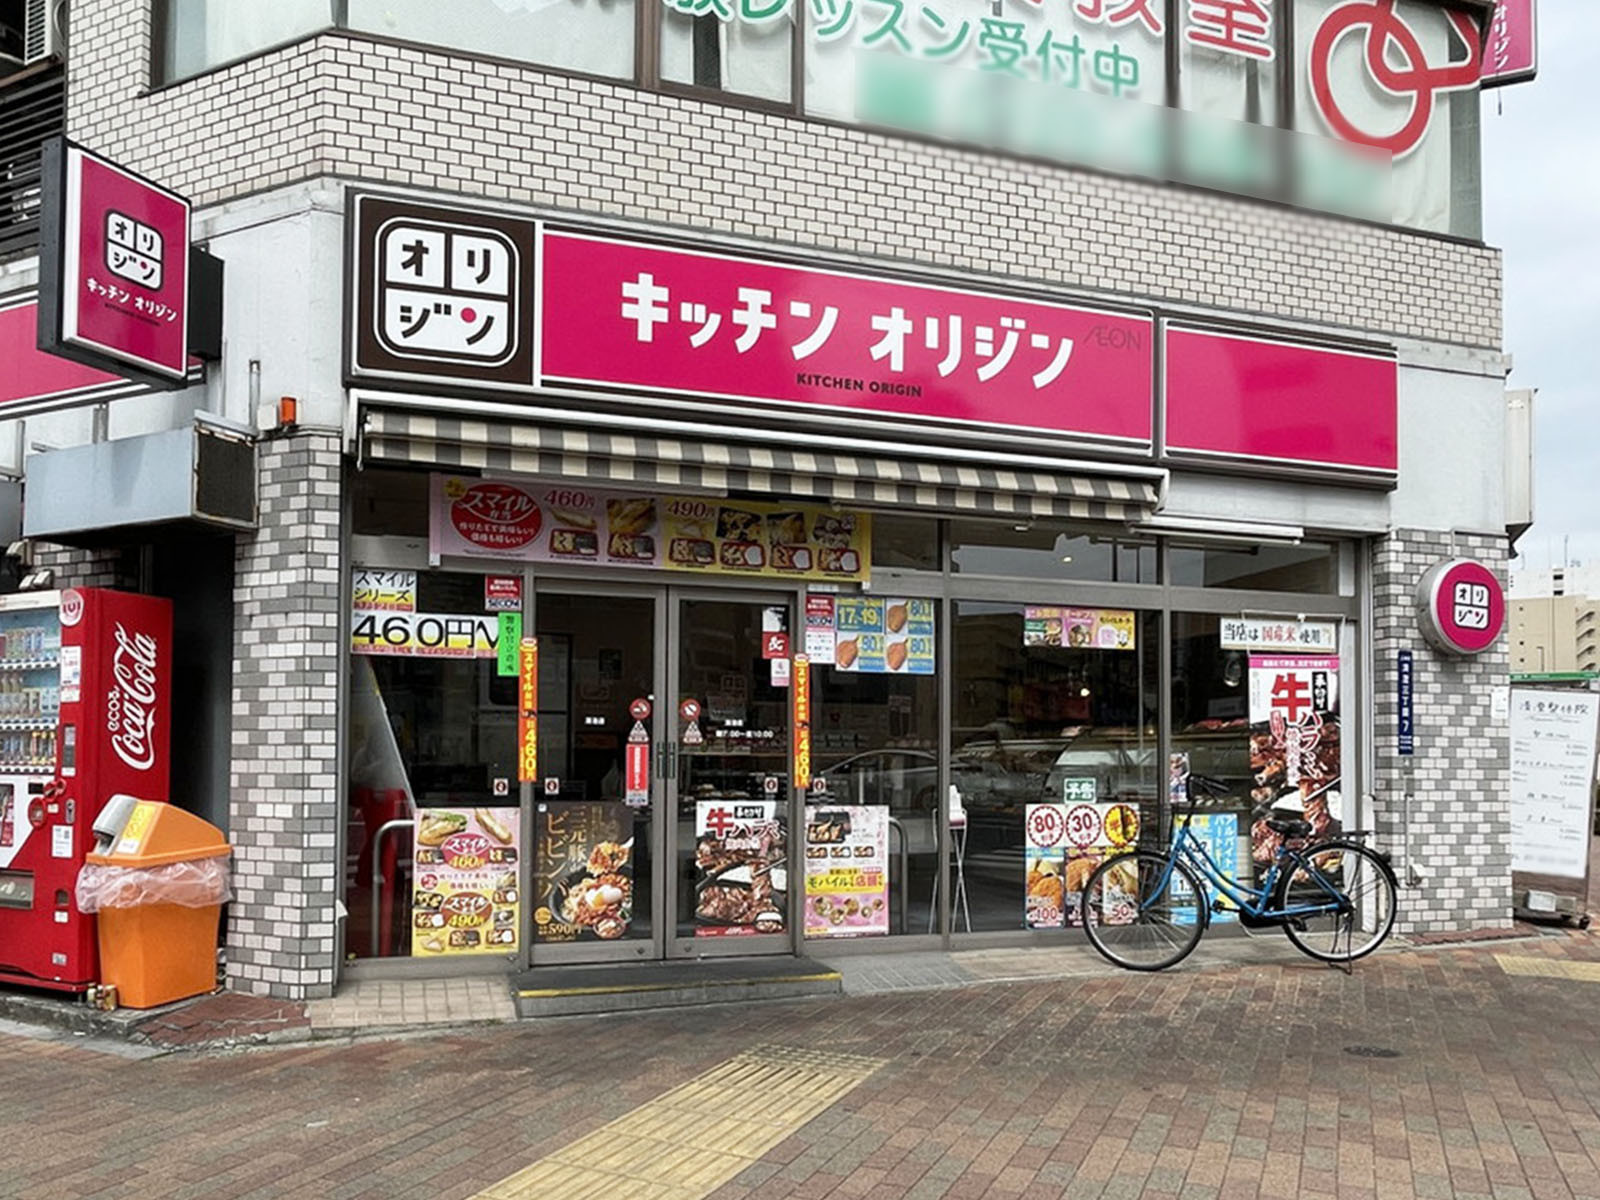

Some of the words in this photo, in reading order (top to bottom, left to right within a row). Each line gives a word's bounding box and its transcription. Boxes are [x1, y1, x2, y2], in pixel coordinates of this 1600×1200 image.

[401, 239, 491, 284] オリ
[87, 278, 130, 303] キッチン
[400, 302, 495, 346] ジン
[621, 272, 839, 361] キッチン
[868, 306, 1074, 390] オリジン
[796, 373, 865, 392] KITCHEN
[868, 381, 922, 398] ORIGIN
[462, 491, 533, 512] スマイル
[355, 571, 415, 588] スマイル
[354, 588, 410, 602] シリーズ
[111, 621, 158, 770] Coca-Cola
[1034, 813, 1056, 833] 80
[1072, 812, 1092, 832] 30
